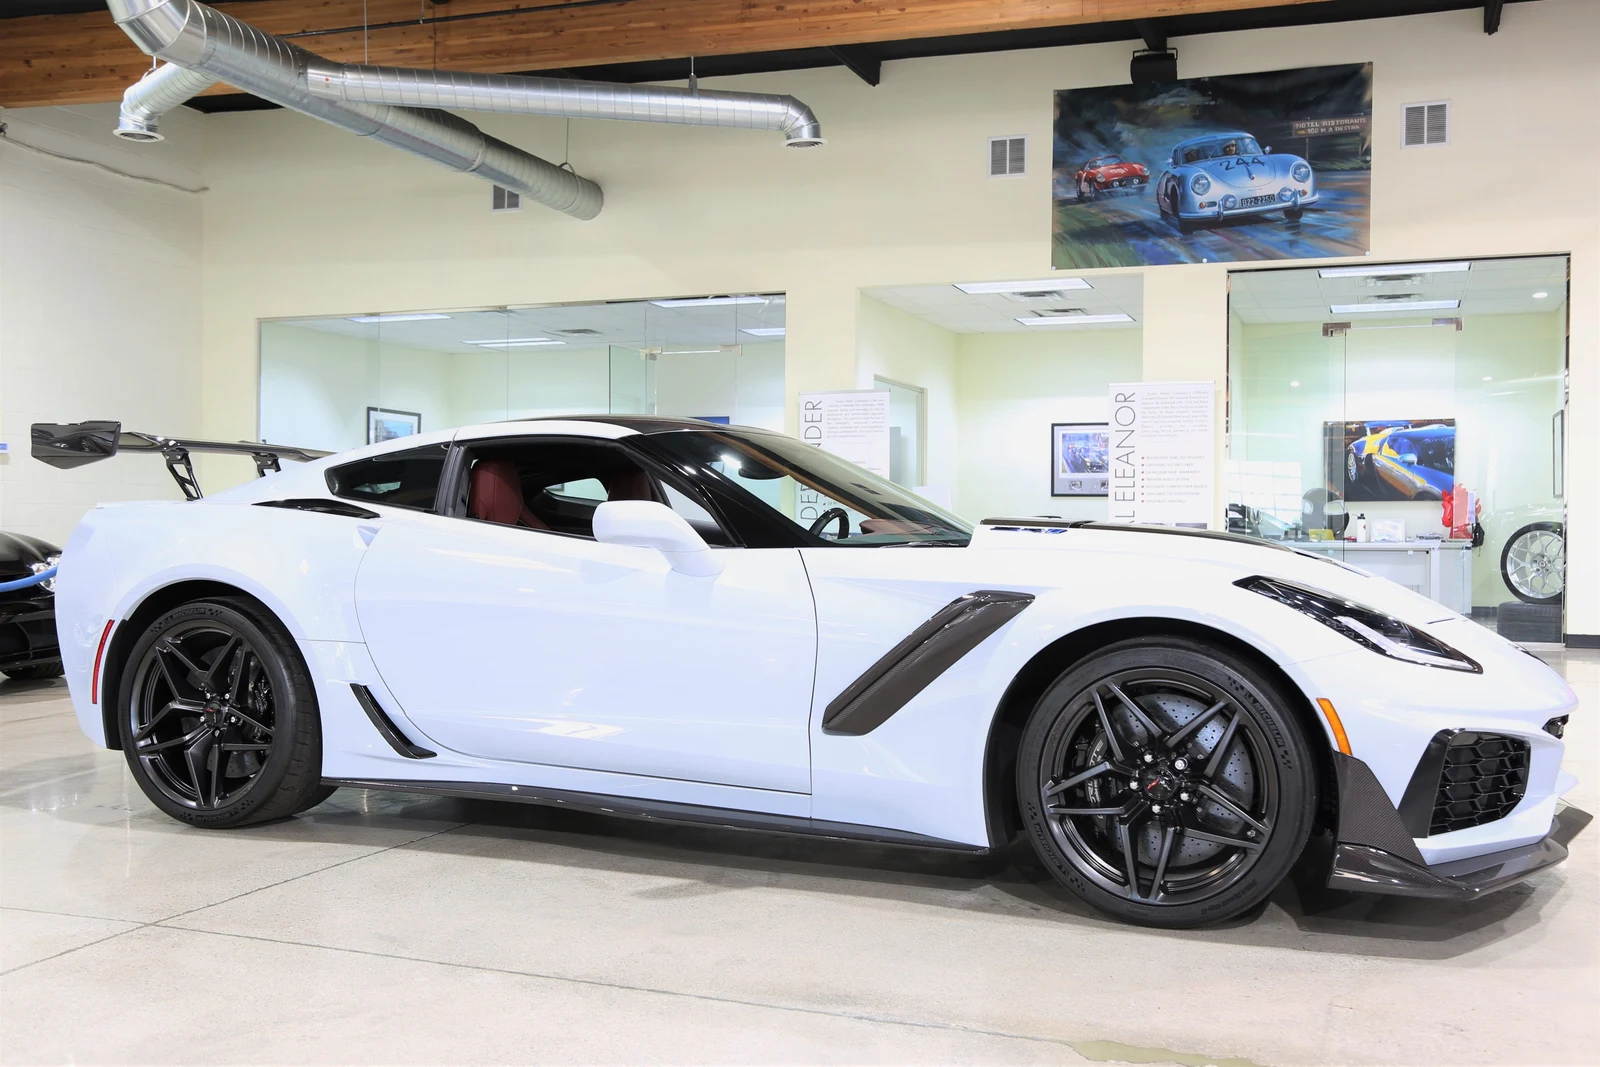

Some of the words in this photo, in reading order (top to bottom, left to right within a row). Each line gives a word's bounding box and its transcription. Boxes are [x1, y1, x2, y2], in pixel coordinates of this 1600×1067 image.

[1296, 121, 1320, 129] HOTEL
[1322, 118, 1366, 127] RISTORANTE
[1219, 157, 1266, 171] 244
[1114, 392, 1136, 502] ELEANOR
[172, 608, 206, 620] MICHELIN
[1253, 702, 1285, 748] MICHELIN
[1033, 823, 1062, 868] MICHELIN
